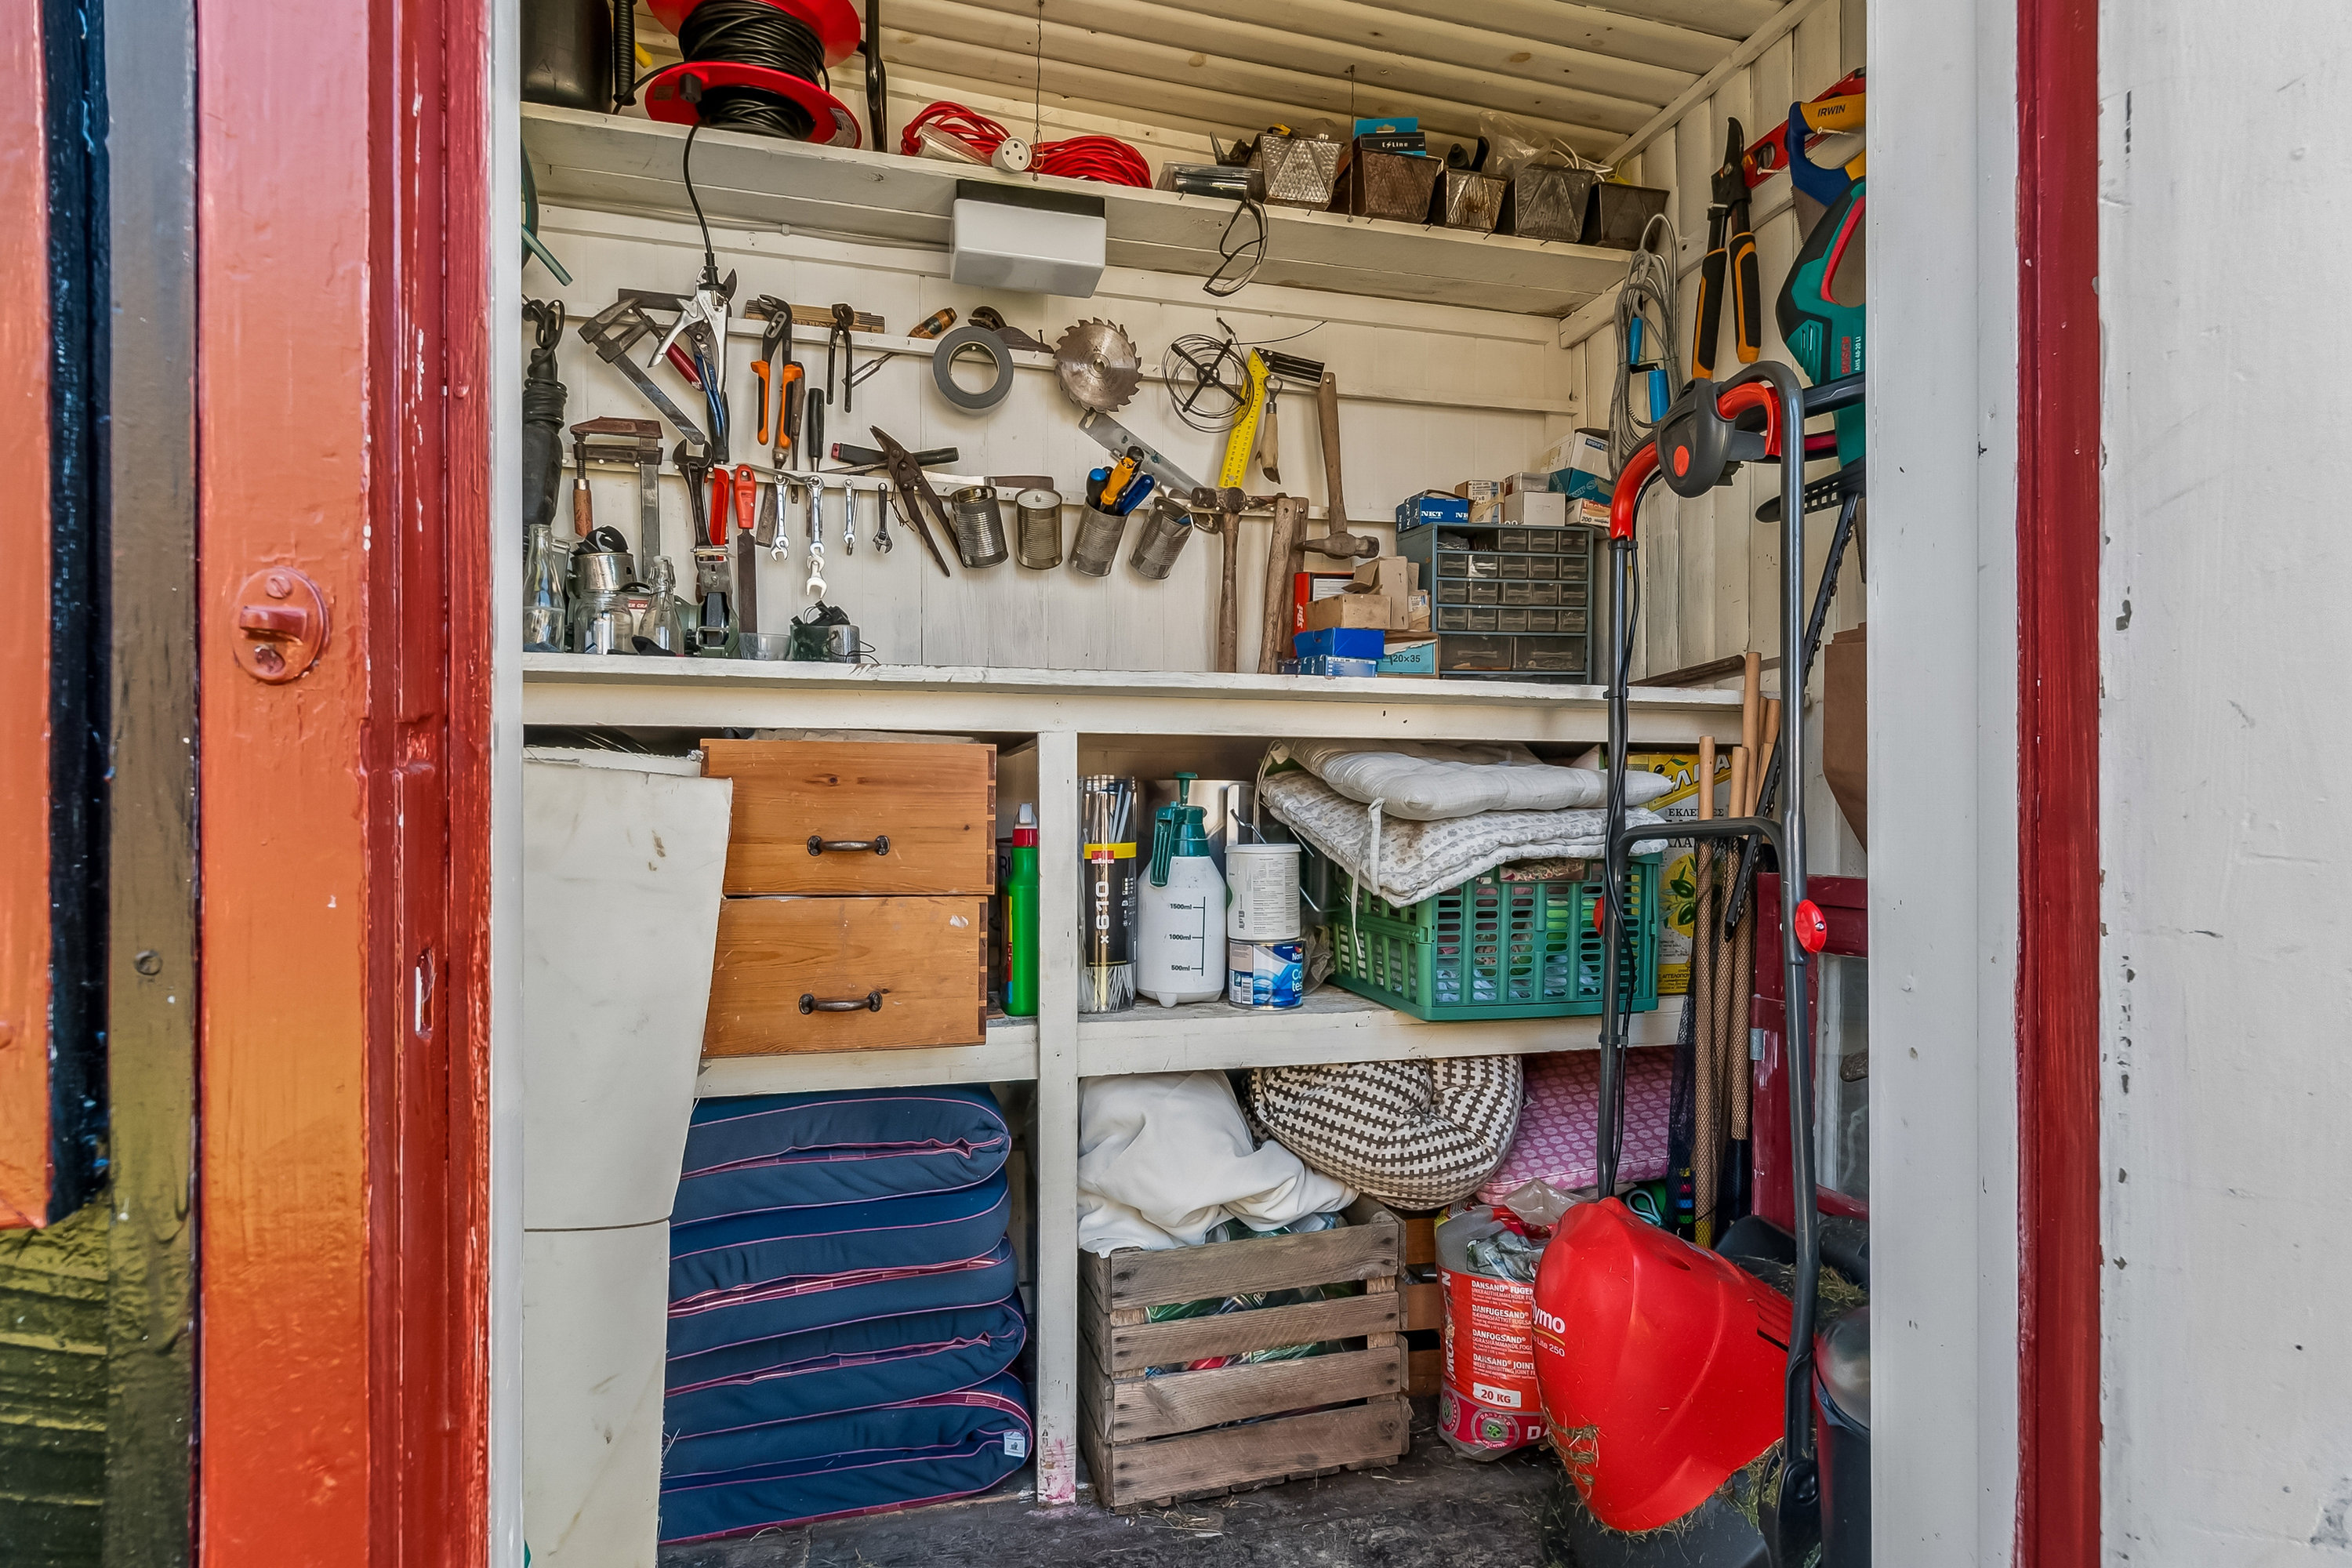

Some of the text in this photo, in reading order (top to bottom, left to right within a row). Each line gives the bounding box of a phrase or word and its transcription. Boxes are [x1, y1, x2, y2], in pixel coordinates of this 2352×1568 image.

[1817, 104, 1846, 118] IRWIN
[1548, 1343, 1566, 1357] 250
[1480, 1388, 1512, 1404] 20 KG
